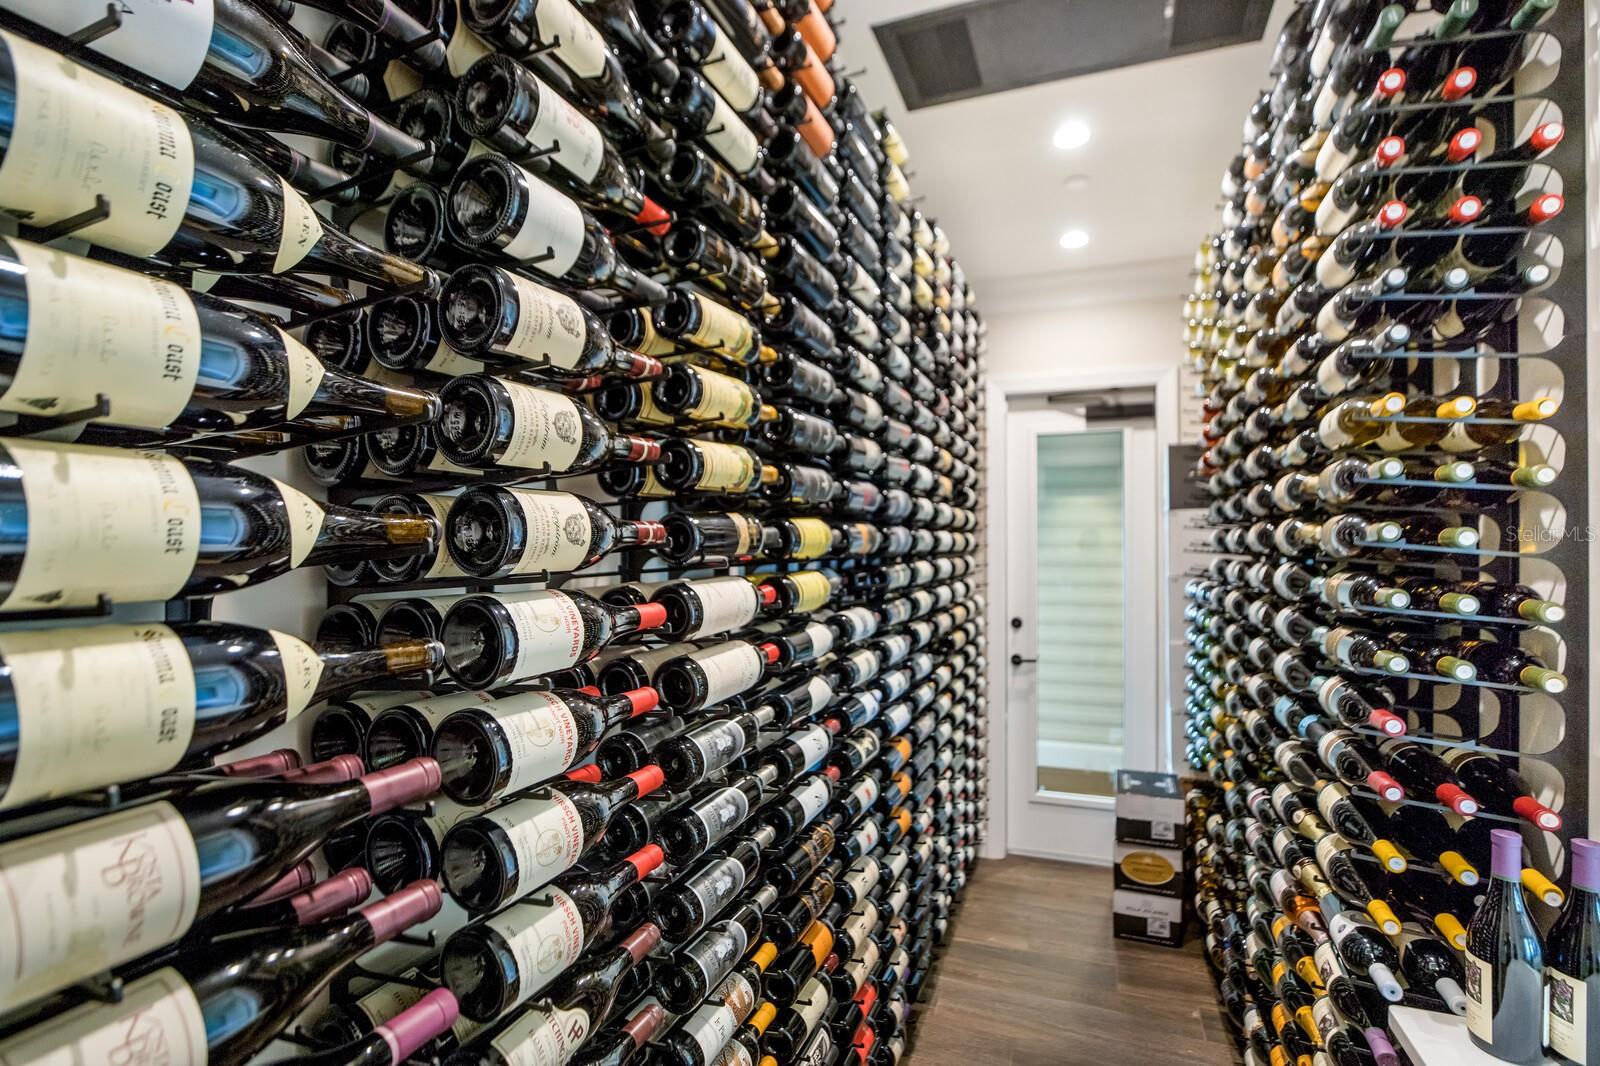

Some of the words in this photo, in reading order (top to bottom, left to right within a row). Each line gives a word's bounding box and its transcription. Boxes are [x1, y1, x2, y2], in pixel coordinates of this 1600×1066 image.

[146, 161, 180, 220] Coast
[162, 324, 192, 382] Coast
[162, 498, 191, 555] Coast
[566, 605, 580, 658] VINEYARDS
[561, 713, 574, 767] VINEYARDS
[552, 793, 576, 824] HIRSCH
[553, 894, 577, 926] HIRSCH
